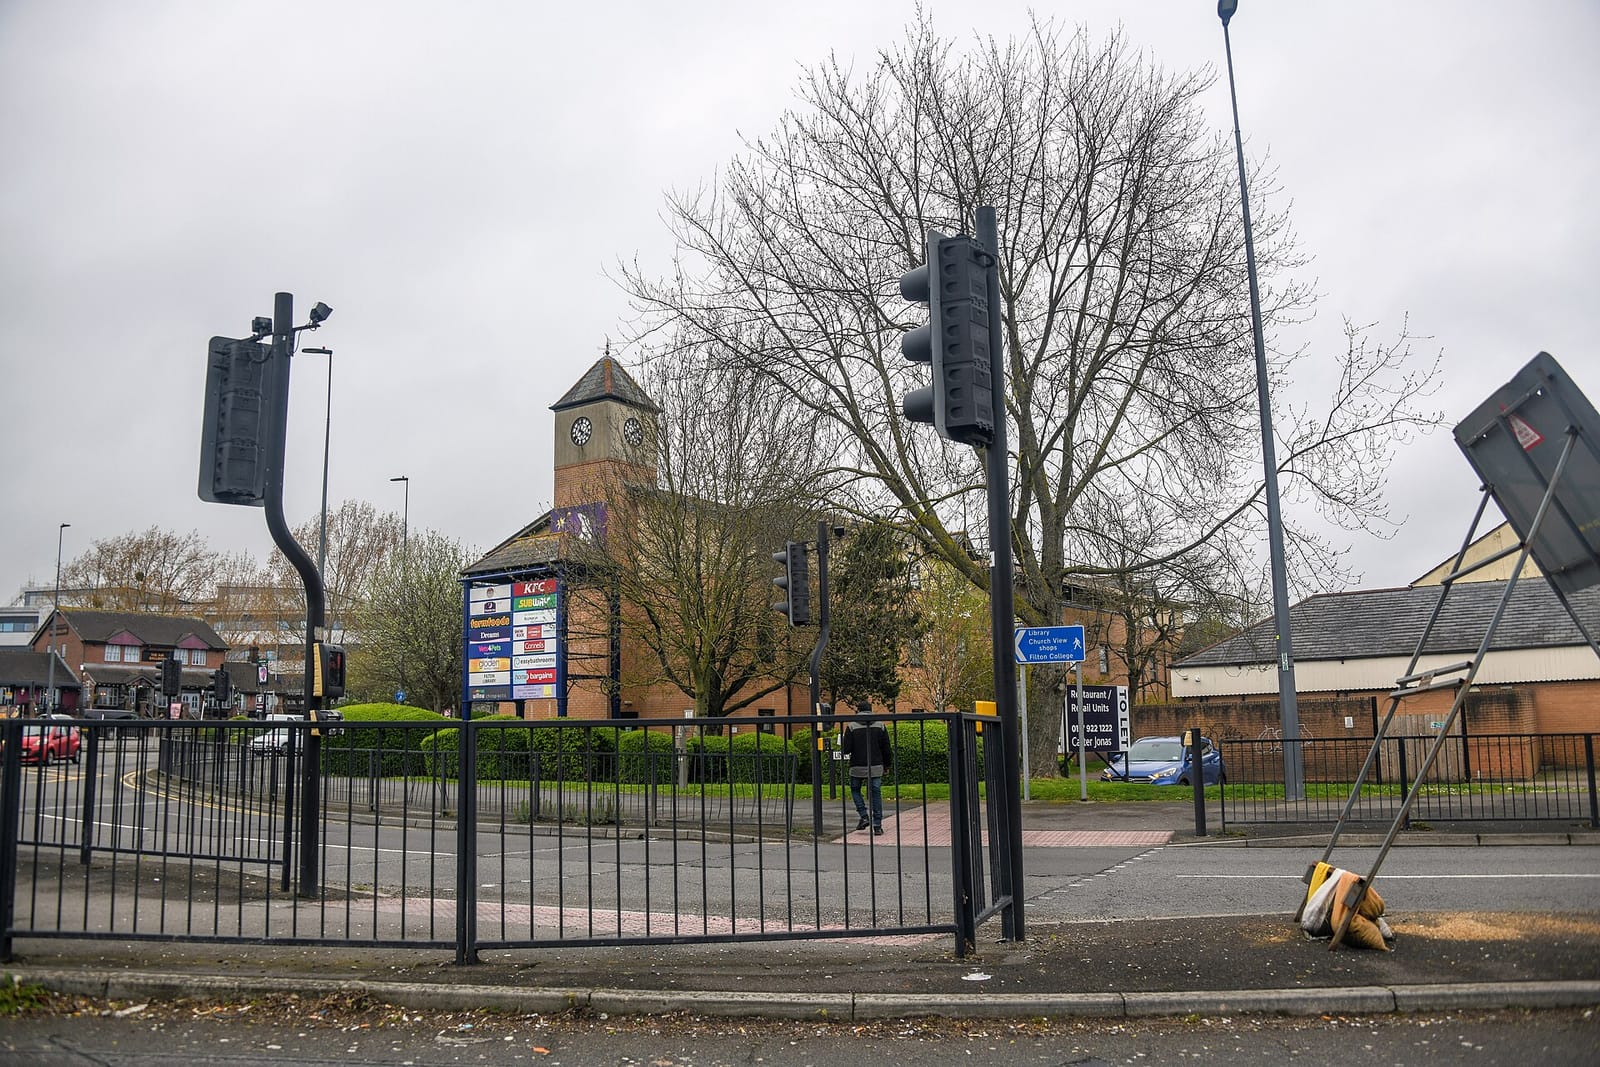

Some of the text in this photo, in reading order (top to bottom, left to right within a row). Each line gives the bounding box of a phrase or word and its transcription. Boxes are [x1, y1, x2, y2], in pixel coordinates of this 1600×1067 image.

[524, 582, 546, 594] KFC
[518, 598, 550, 608] SUBWAY
[470, 616, 510, 628] farmfoods
[520, 656, 555, 664] easybathrooms
[530, 671, 552, 680] bargains
[1071, 690, 1106, 699] Rtaurant
[1072, 704, 1109, 712] Reail Units
[1120, 690, 1128, 748] TO LET
[1072, 736, 1112, 748] Cater Jonas
